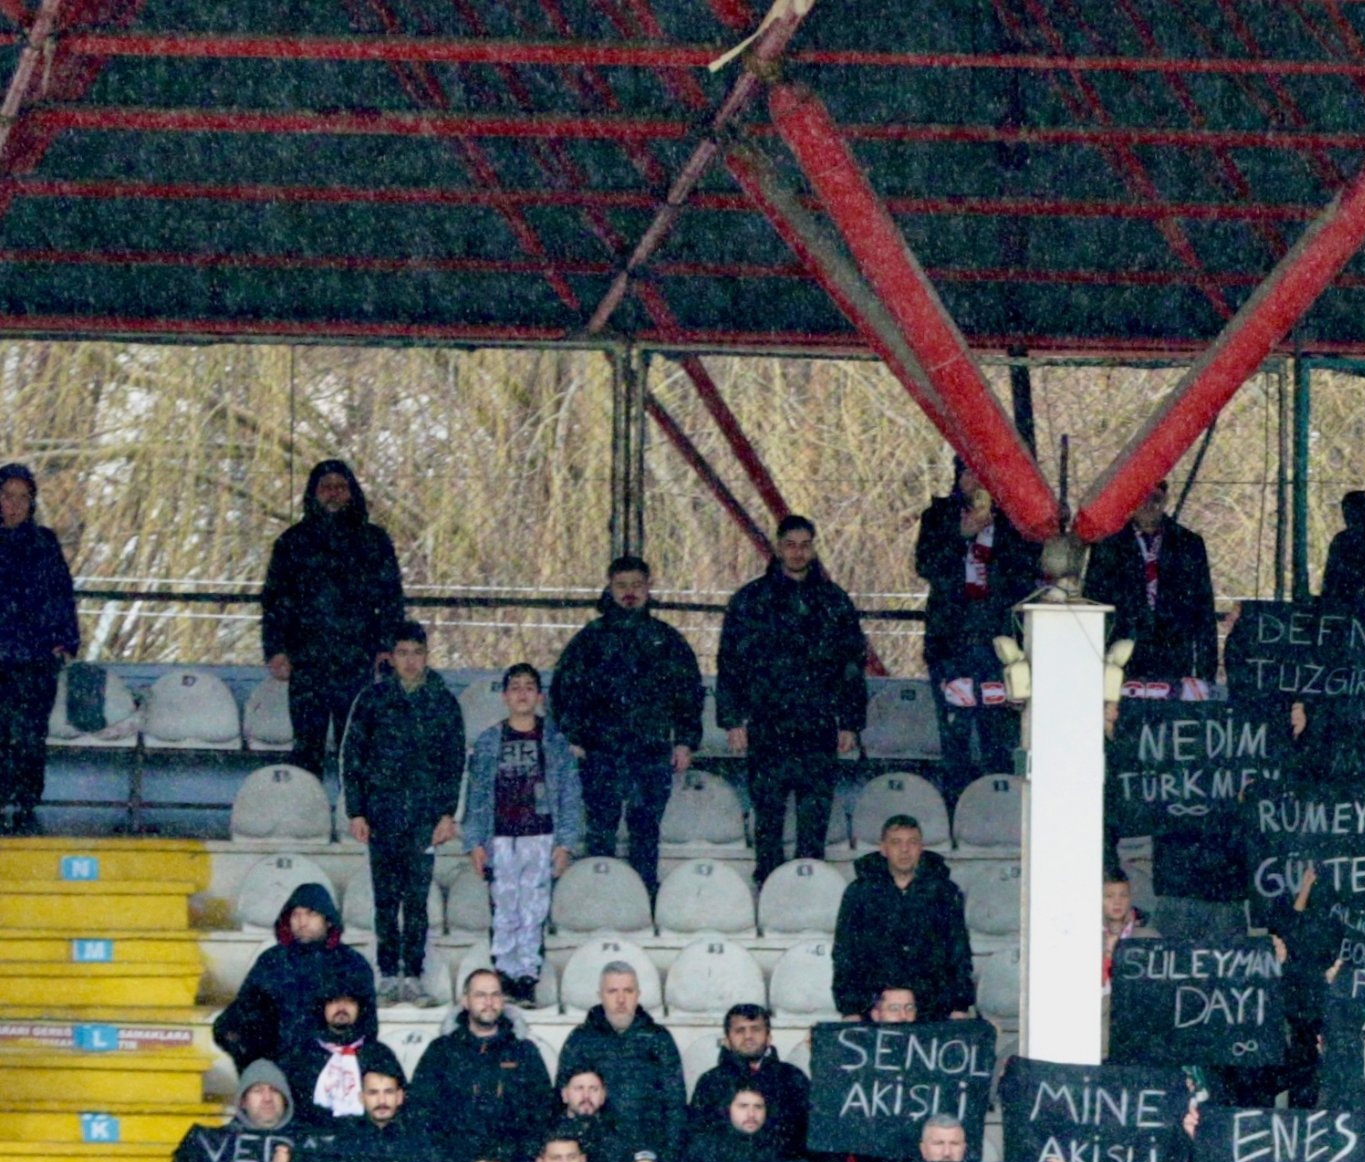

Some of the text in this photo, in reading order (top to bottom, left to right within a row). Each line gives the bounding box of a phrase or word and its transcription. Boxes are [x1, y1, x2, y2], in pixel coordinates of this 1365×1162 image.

[1138, 708, 1269, 762] NEDİM
[1120, 768, 1280, 801] TÜRKME
[1173, 985, 1267, 1029] DAYI
[93, 1031, 107, 1047] L
[1028, 1075, 1169, 1130] MİNE
[91, 1122, 110, 1138] K
